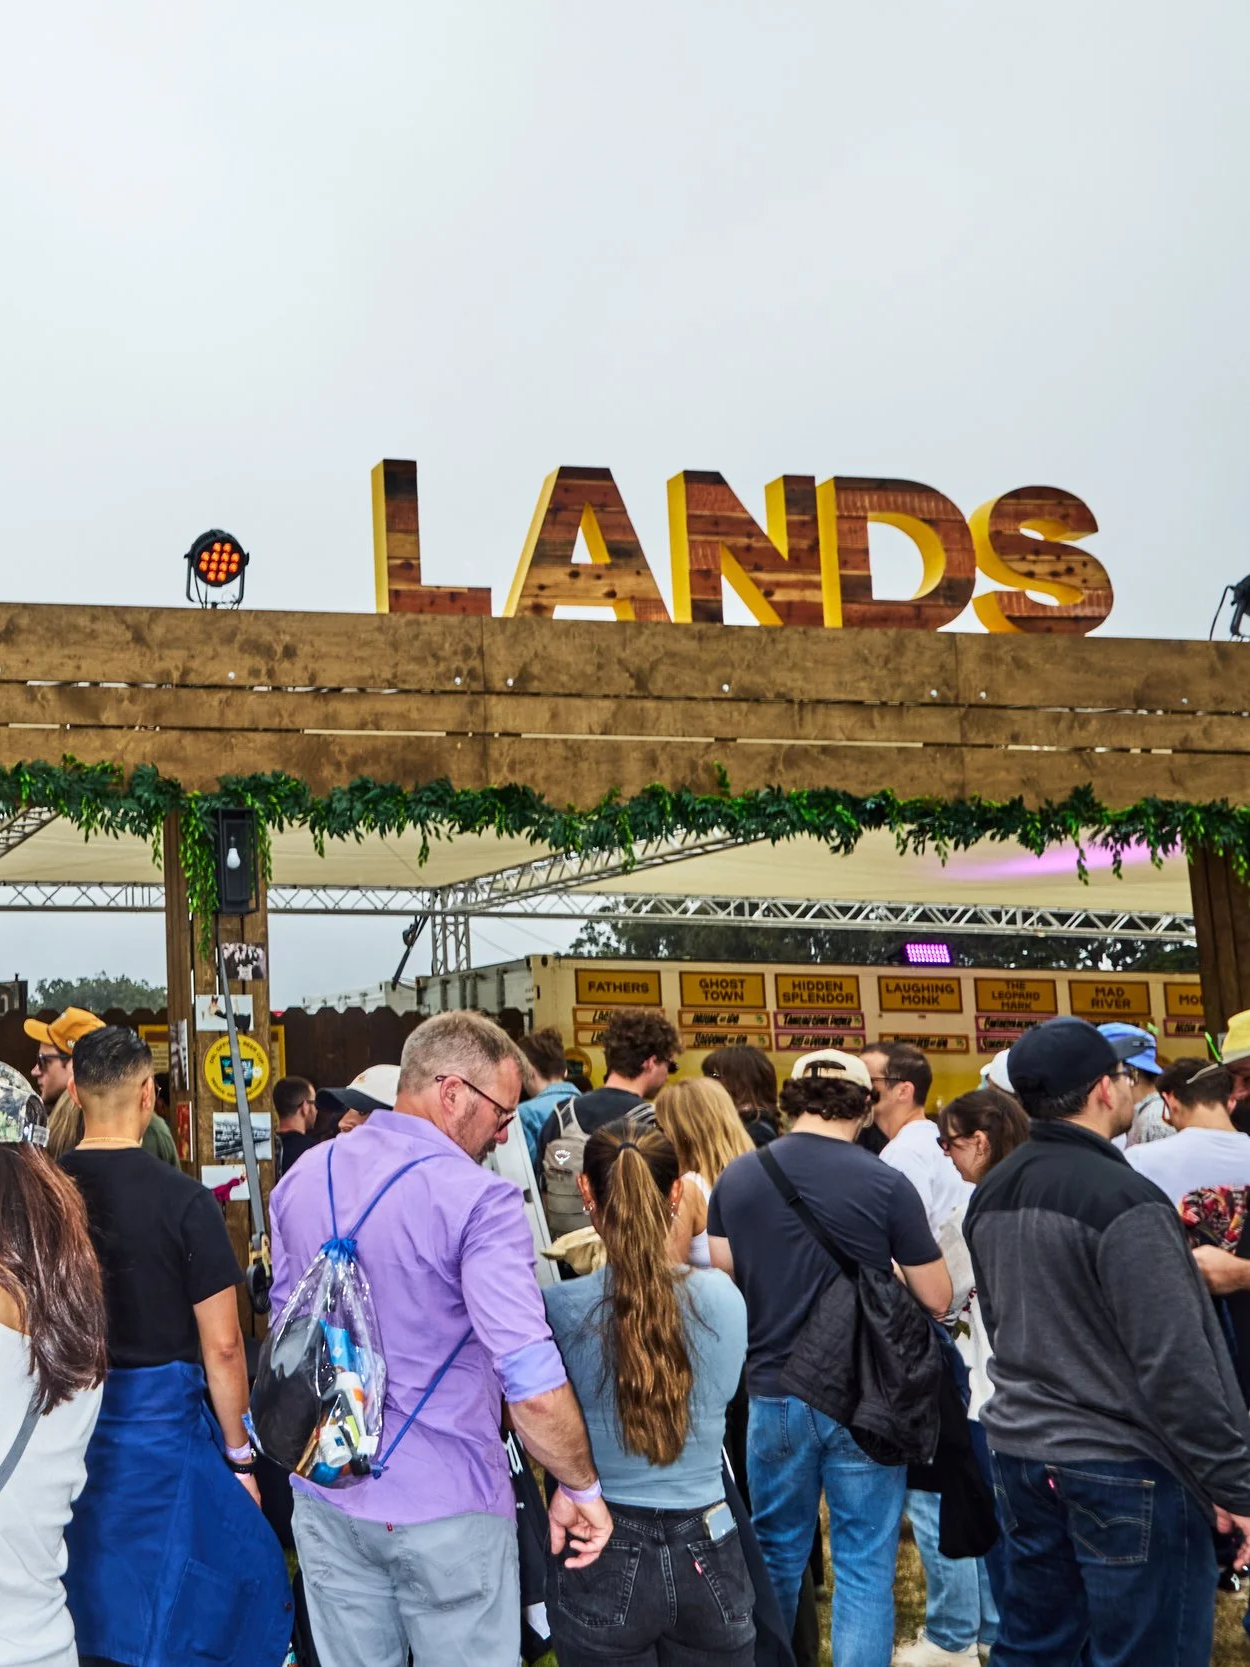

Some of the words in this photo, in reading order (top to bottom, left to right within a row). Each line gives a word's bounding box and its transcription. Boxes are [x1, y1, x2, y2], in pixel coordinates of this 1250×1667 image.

[371, 458, 1113, 634] LANDS
[588, 981, 649, 994] FATHERS
[699, 979, 746, 990] GHOST
[791, 981, 843, 992] HIDDEN
[885, 982, 955, 995] LAUGHING
[1005, 980, 1026, 990] THE
[702, 991, 745, 1002] TOWN
[782, 992, 854, 1003] SPLENDOR
[991, 991, 1041, 1001] LEOPARD
[1095, 987, 1125, 997] MAD
[901, 995, 940, 1006] MONK
[1001, 1001, 1032, 1010] MARK
[1091, 998, 1131, 1009] RIVER
